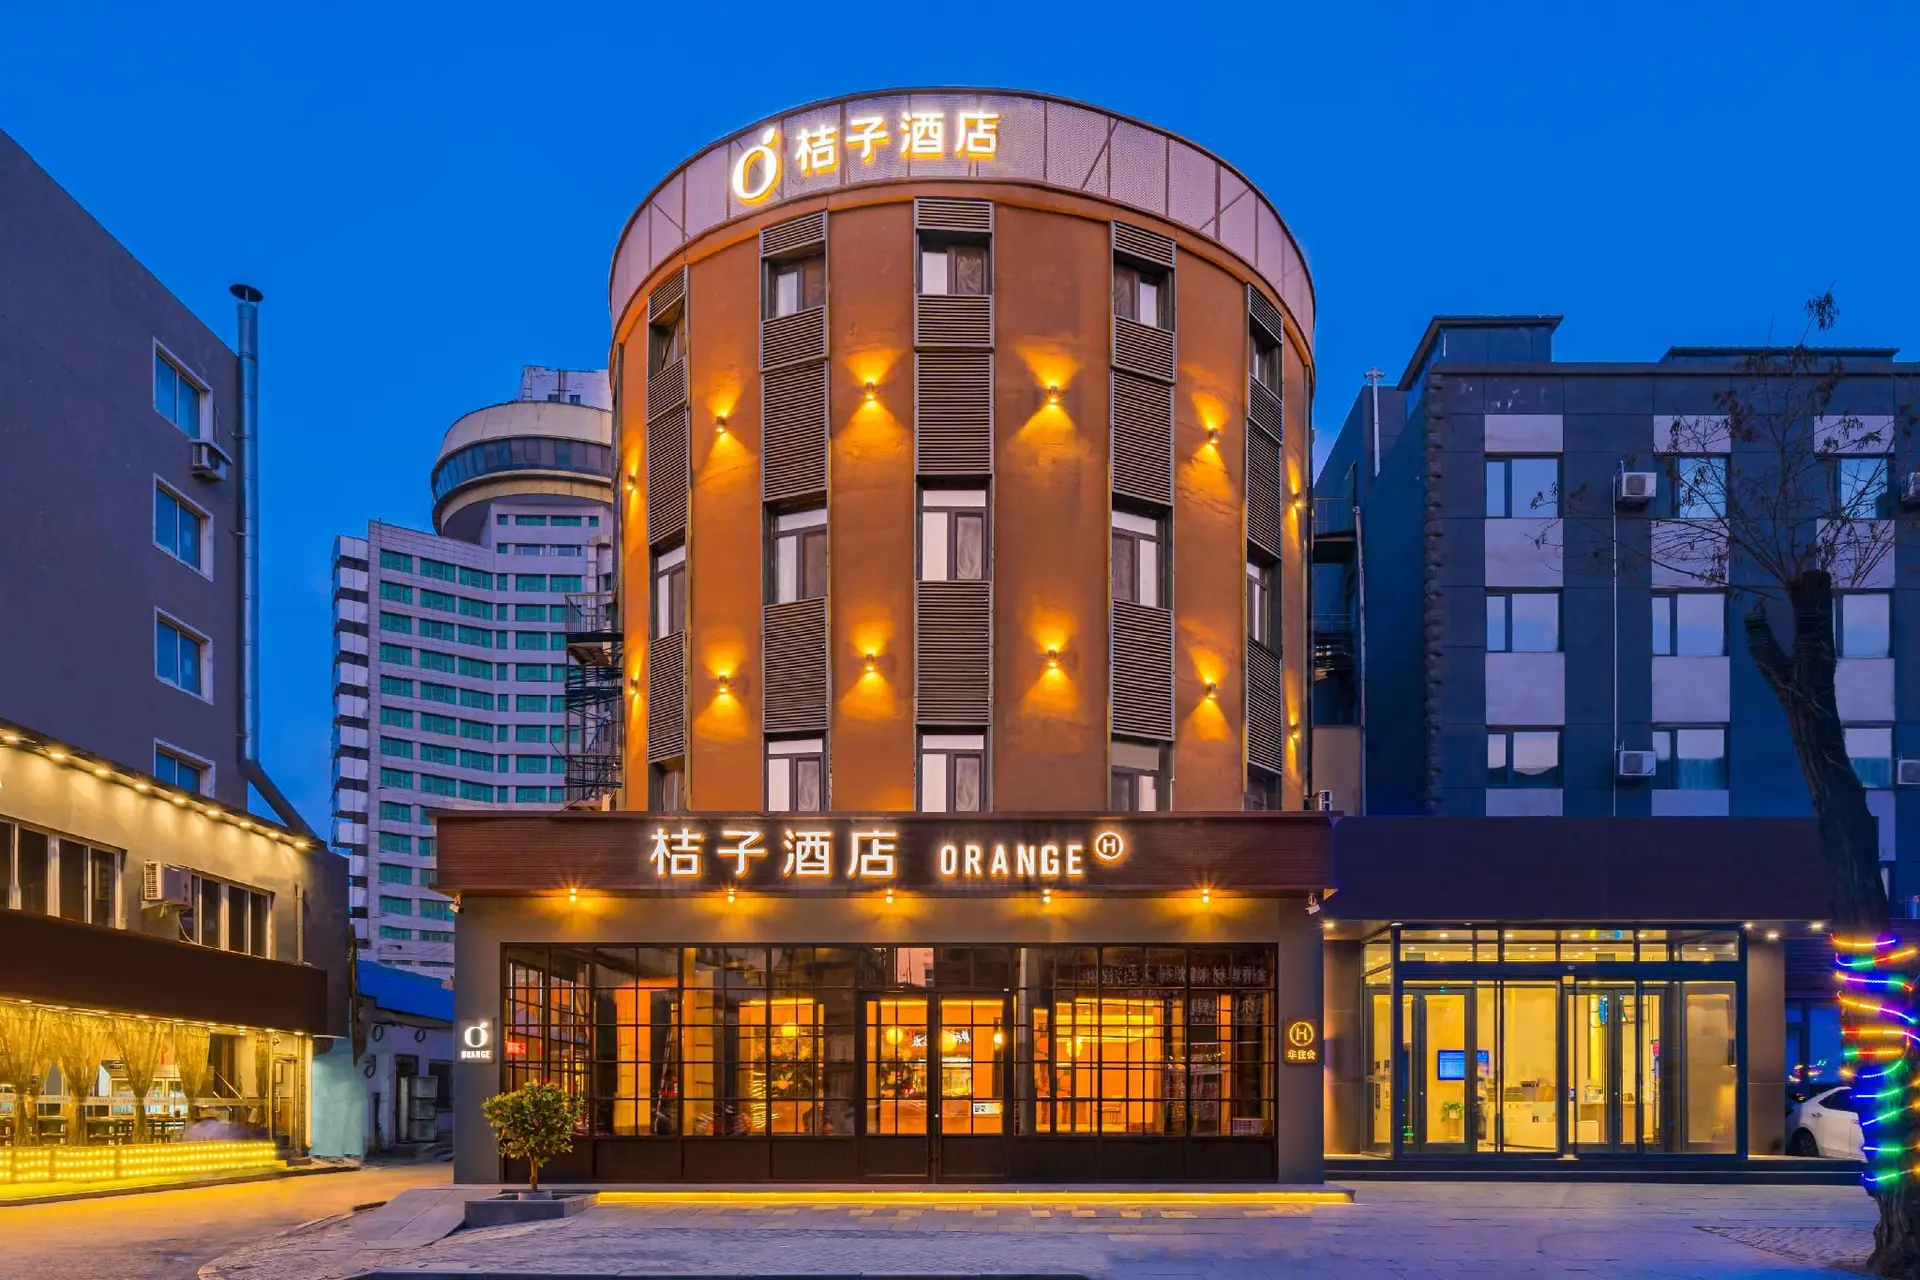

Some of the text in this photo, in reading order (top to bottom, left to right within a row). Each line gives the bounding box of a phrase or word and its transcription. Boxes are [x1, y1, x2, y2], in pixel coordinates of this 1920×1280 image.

[794, 110, 1000, 172] 桔子酒店
[650, 828, 897, 878] 桔子酒店
[939, 844, 1084, 877] ORANGE
